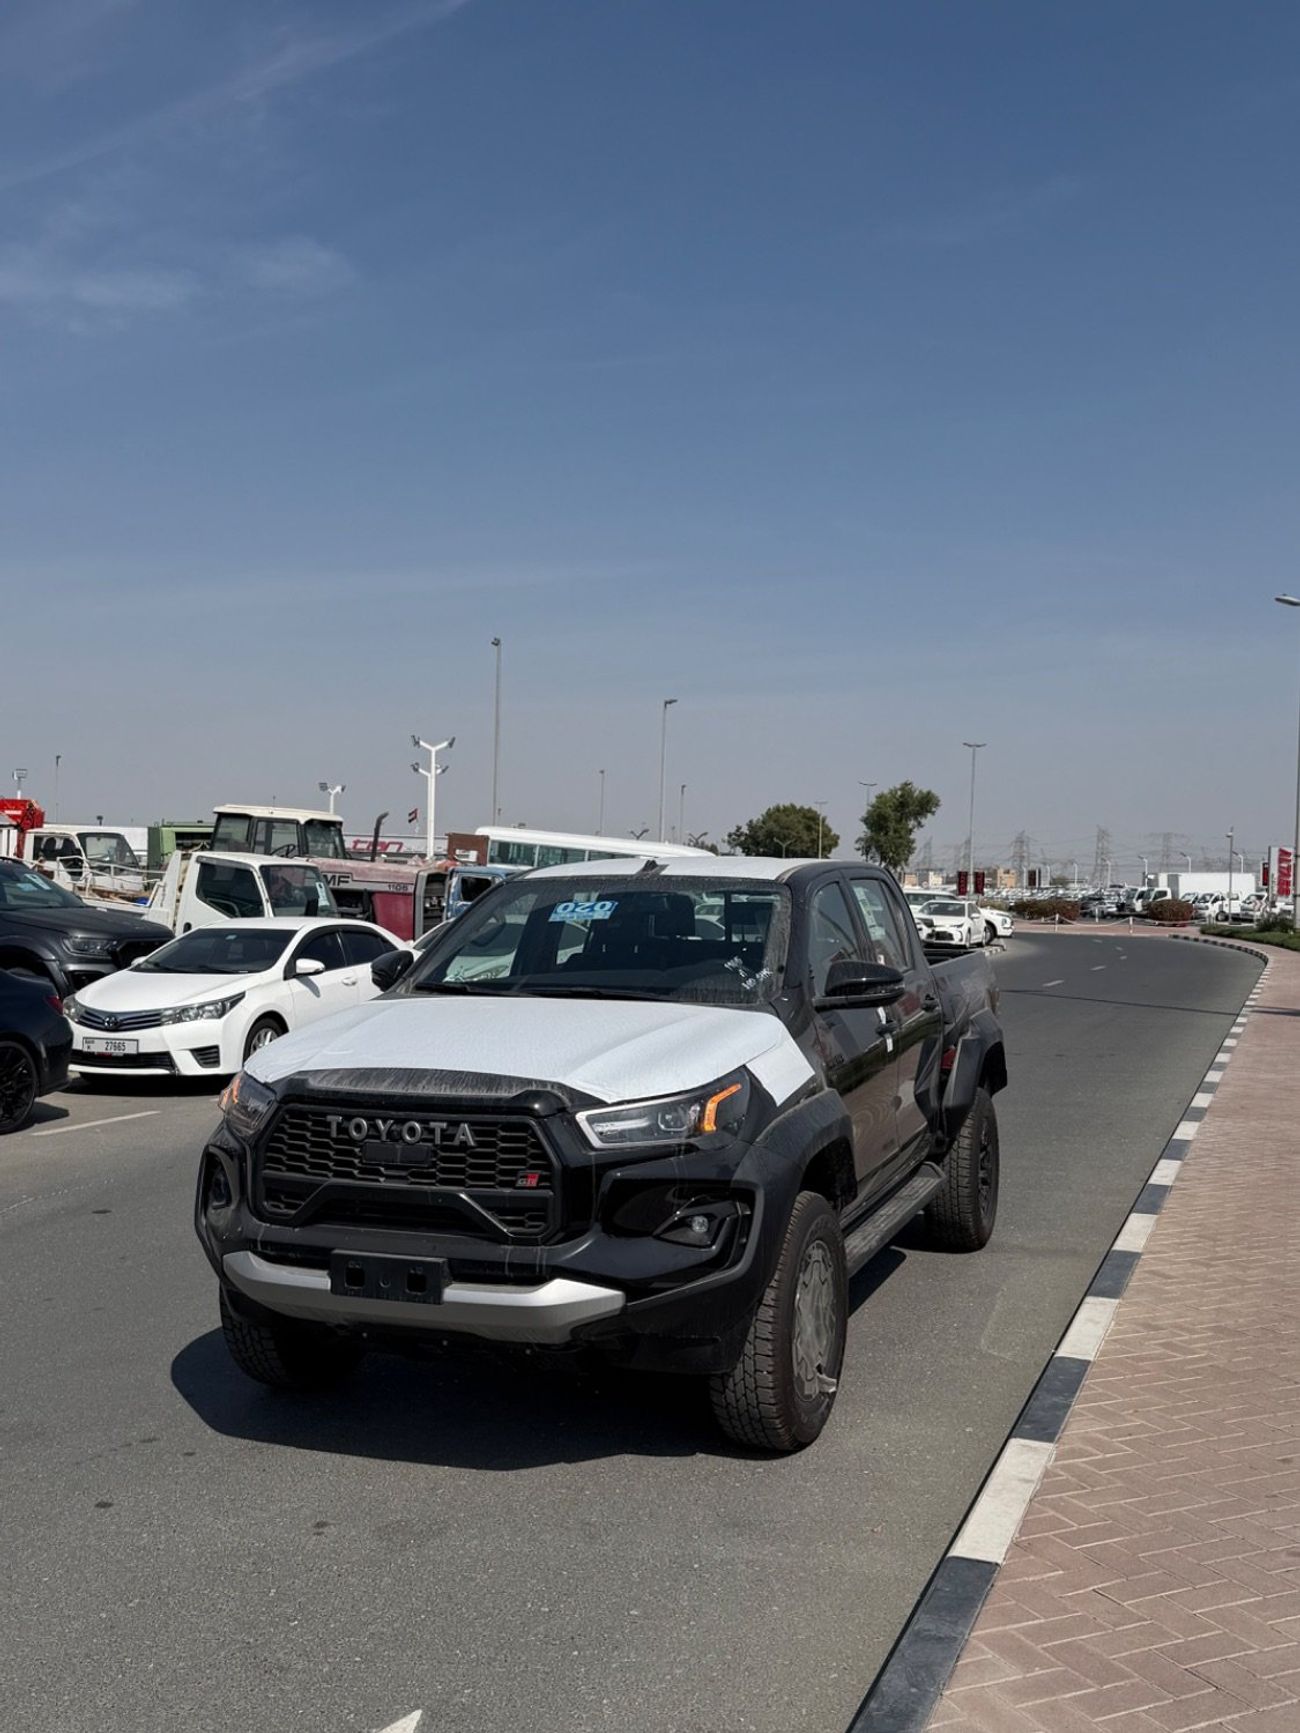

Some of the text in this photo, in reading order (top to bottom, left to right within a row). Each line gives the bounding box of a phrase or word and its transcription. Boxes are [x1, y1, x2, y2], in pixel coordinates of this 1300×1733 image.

[323, 873, 350, 886] MF
[326, 1115, 477, 1147] TOYOTA
[517, 1173, 540, 1187] GR
